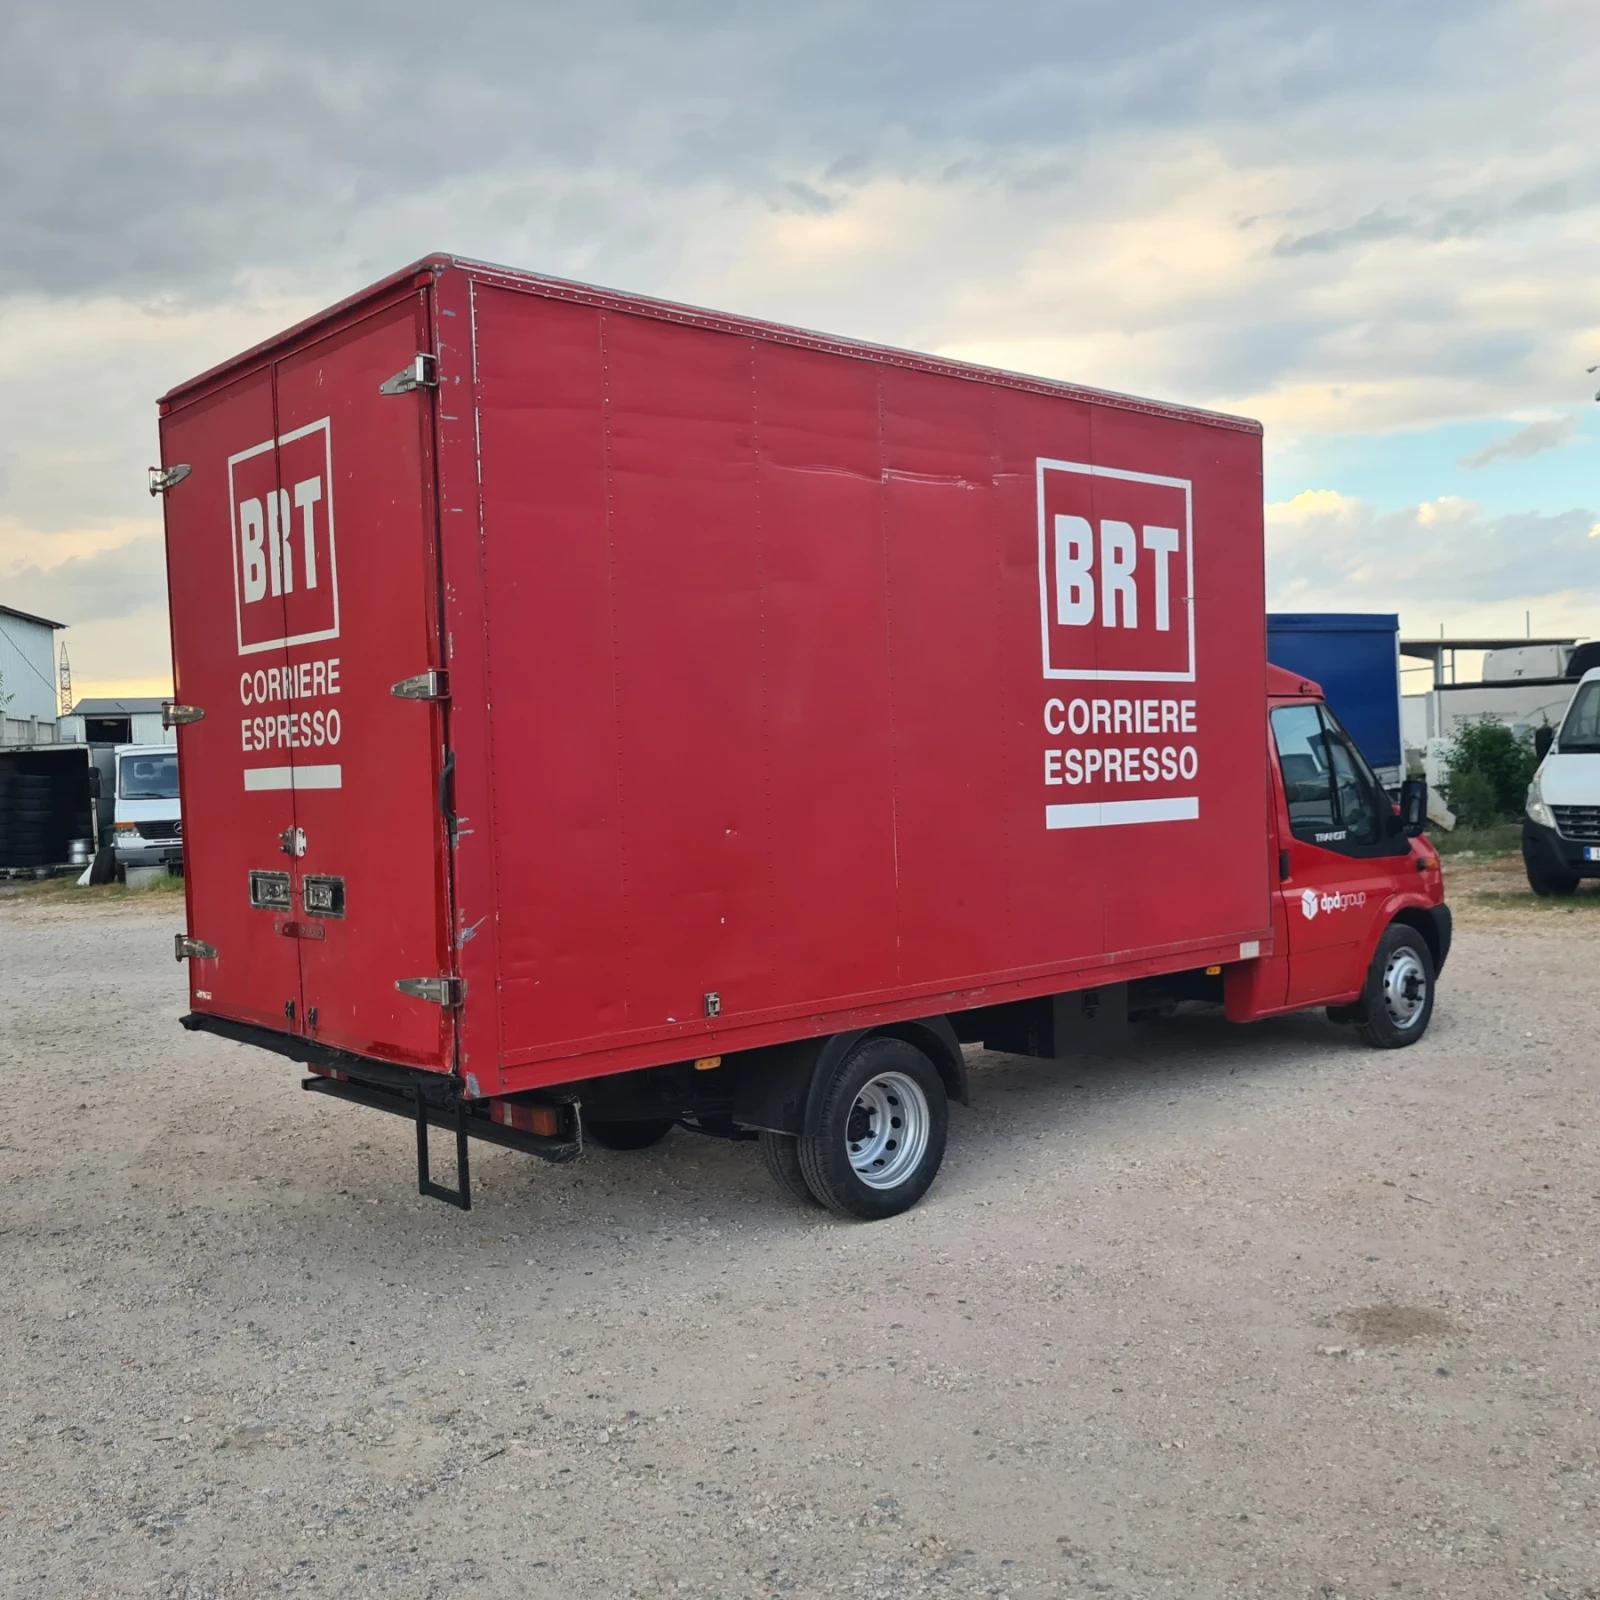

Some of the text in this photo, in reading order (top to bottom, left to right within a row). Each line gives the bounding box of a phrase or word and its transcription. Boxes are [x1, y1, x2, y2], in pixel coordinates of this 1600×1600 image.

[240, 476, 321, 604] BRT
[1055, 514, 1179, 631] BRT
[240, 658, 341, 706] CORRIERE
[241, 709, 341, 752] ESPRESSO
[1044, 698, 1197, 735] CORRIERE
[1045, 746, 1198, 785] ESPRESSO
[1315, 830, 1347, 842] TRANSIT
[1320, 890, 1366, 914] dpdgroup
